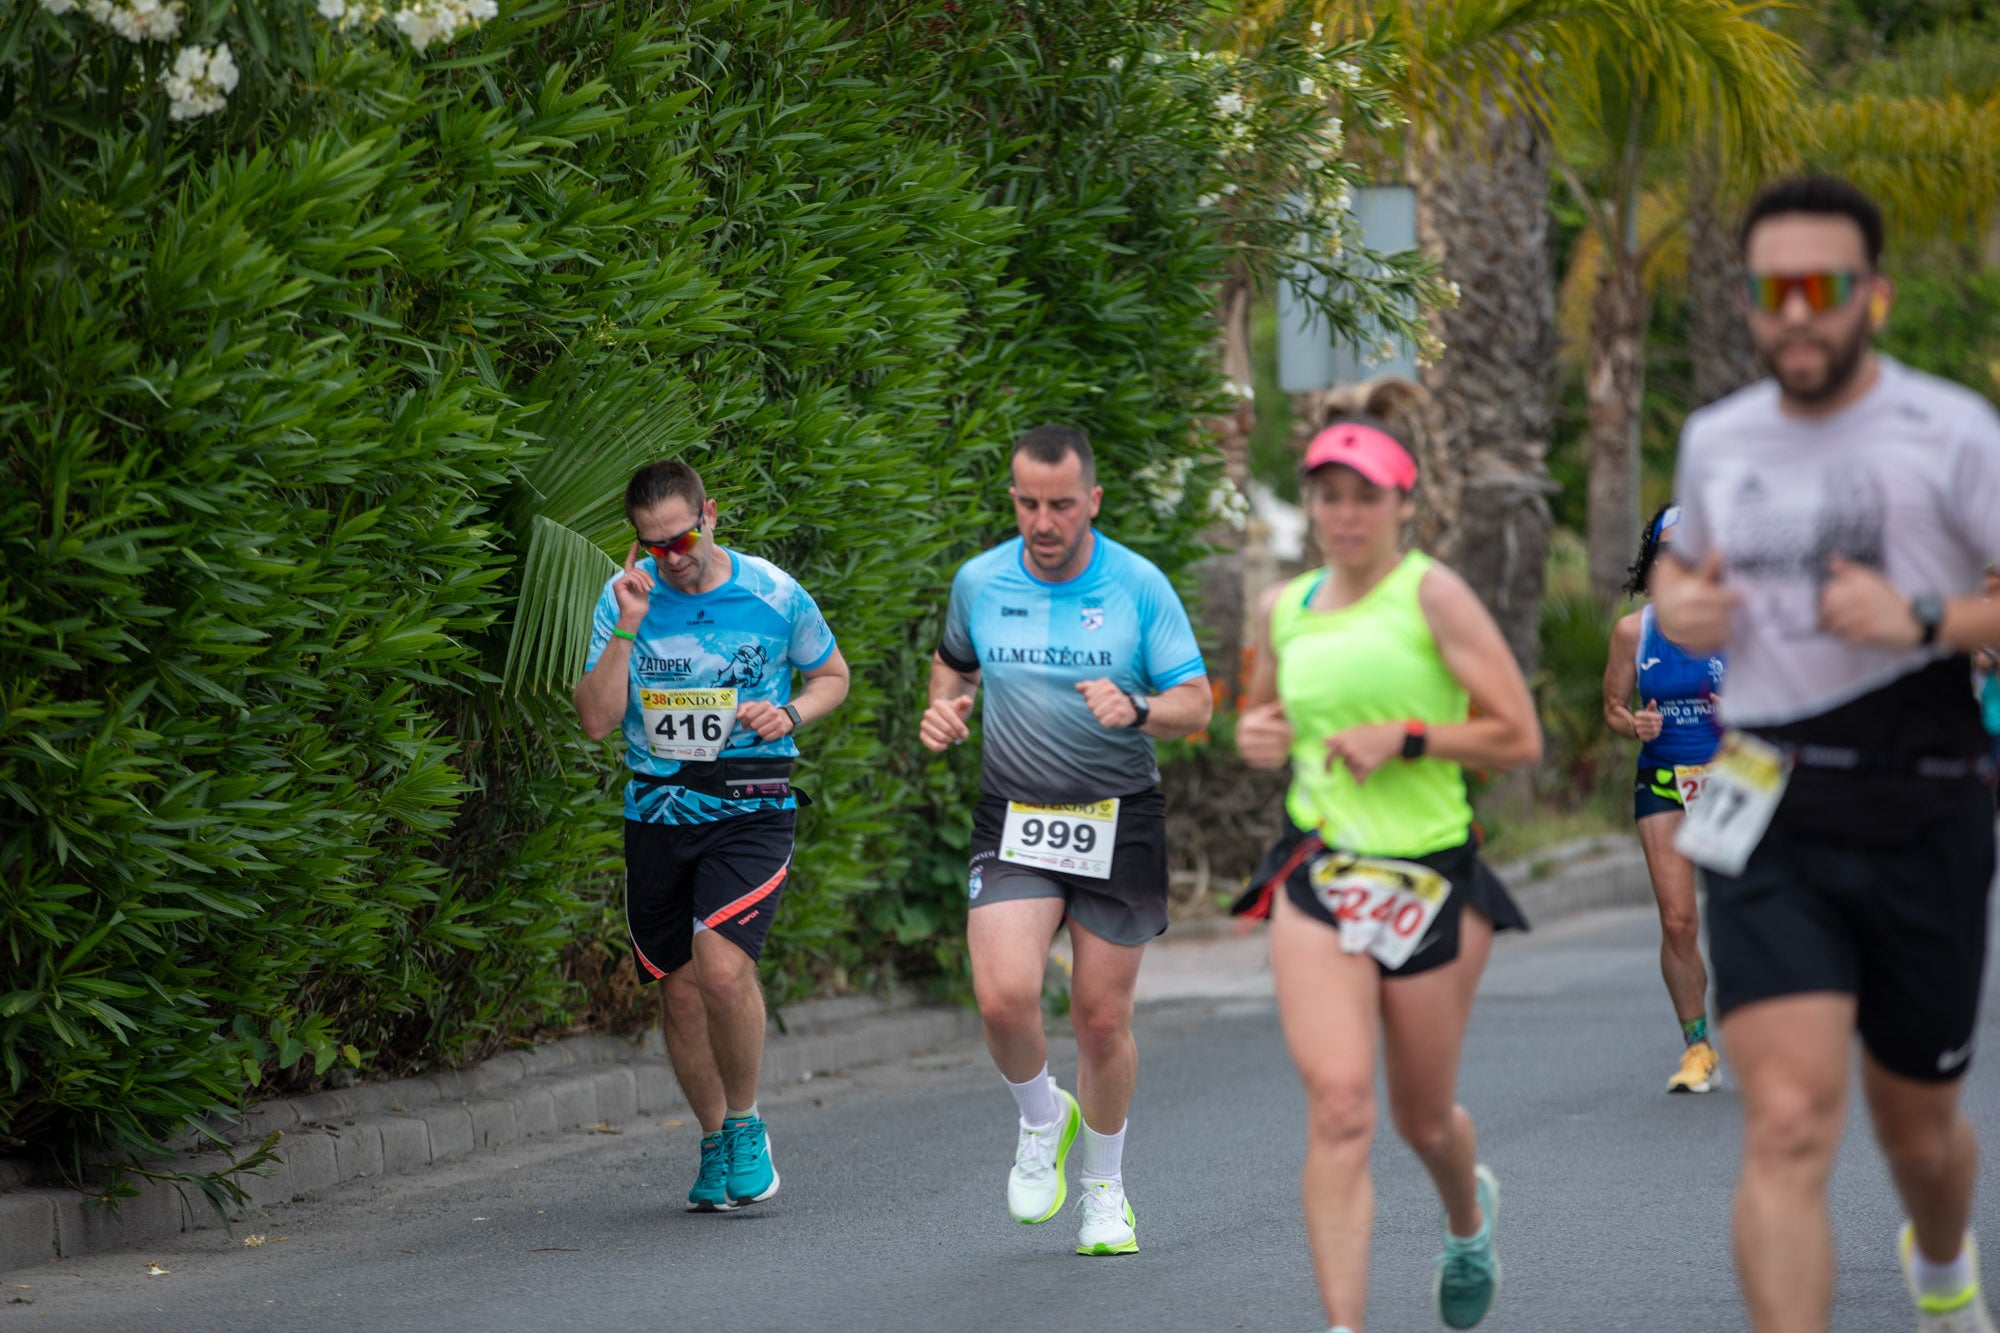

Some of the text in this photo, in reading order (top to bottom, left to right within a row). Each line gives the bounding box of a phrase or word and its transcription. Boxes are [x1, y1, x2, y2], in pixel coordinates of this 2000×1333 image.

[638, 656, 692, 673] ZATOPEK
[988, 646, 1112, 667] ALMUÑÉCAR
[652, 693, 716, 705] 38 FONDO
[655, 714, 722, 742] 416
[1020, 818, 1097, 854] 999
